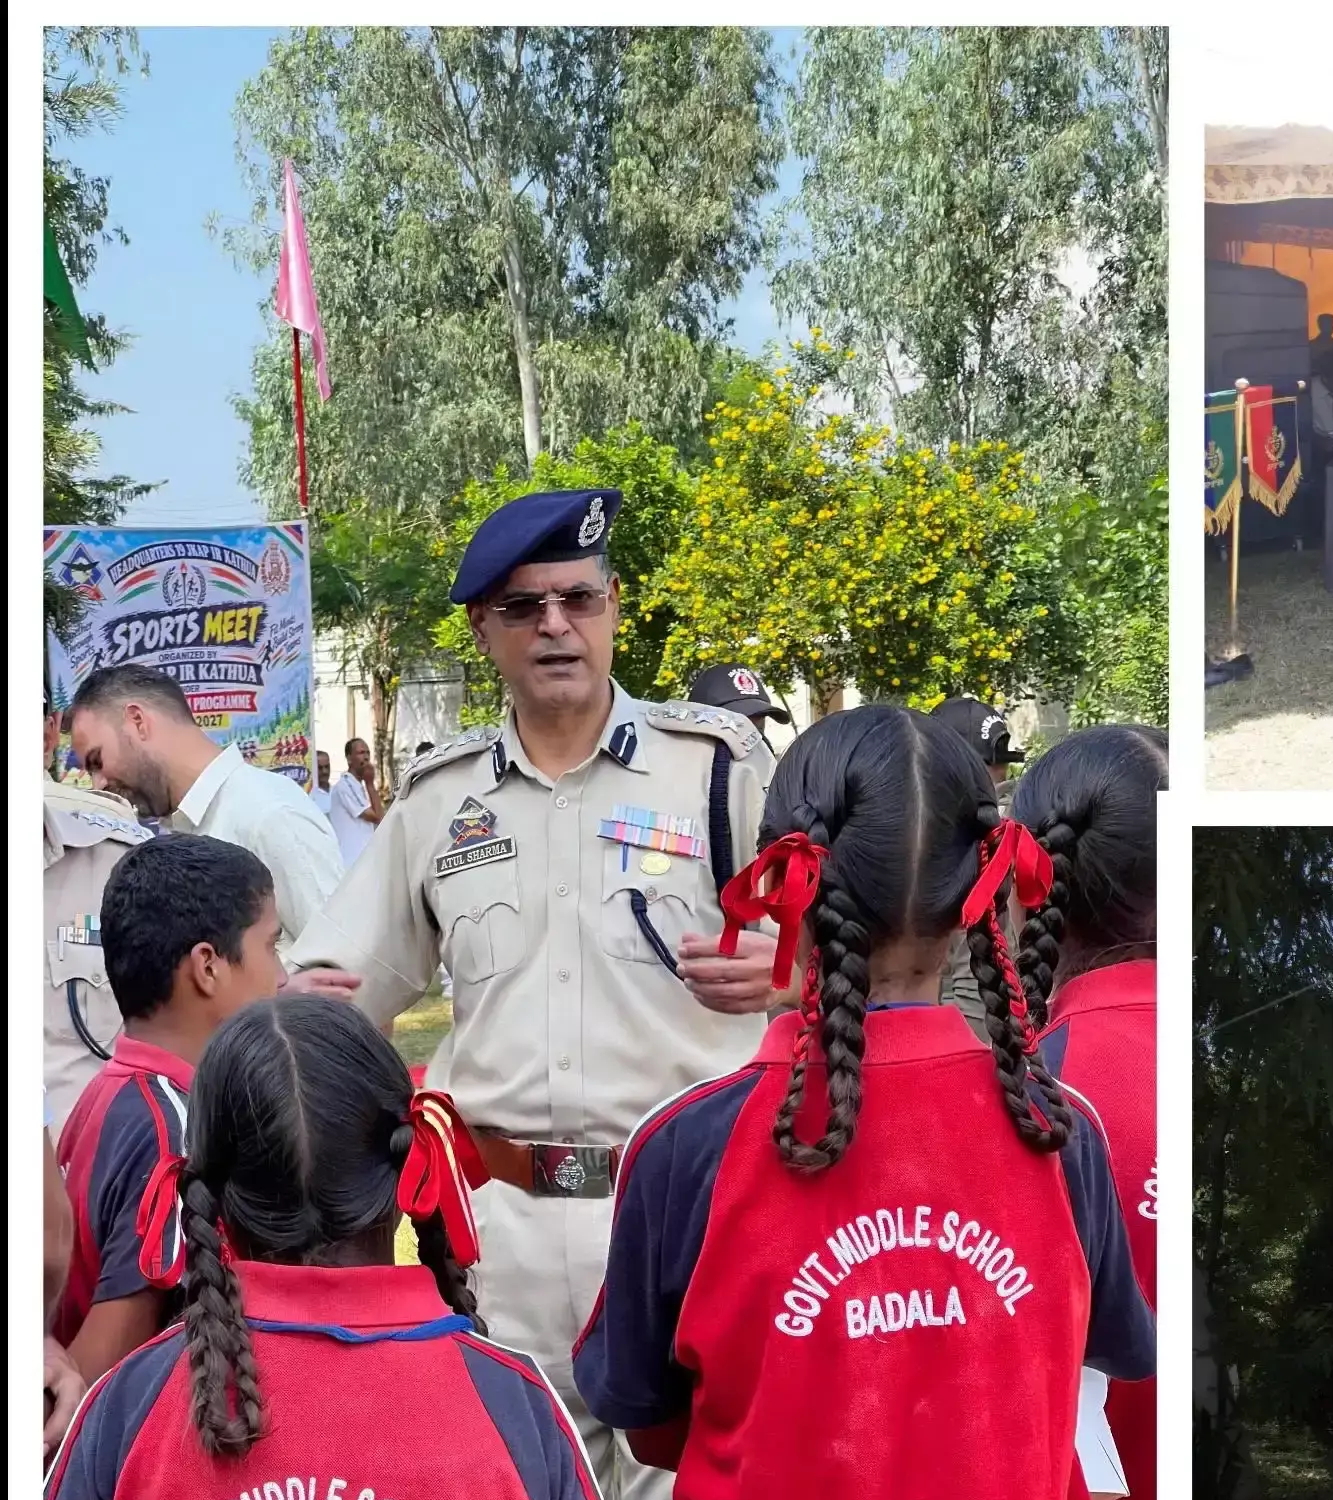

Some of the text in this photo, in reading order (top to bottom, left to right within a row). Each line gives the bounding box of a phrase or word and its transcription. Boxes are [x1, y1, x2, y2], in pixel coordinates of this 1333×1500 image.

[110, 543, 257, 581] HEADQUARTERS 19 JKAP IR KATHUA
[112, 611, 200, 661] SPORTS
[203, 605, 263, 644] MEET
[159, 650, 217, 661] ORGANIZED BY
[180, 664, 195, 681] IR
[198, 663, 257, 682] KATHUA
[194, 695, 252, 711] PROGRAMME
[196, 714, 223, 727] 2027
[441, 843, 507, 870] ATUL SHARMA
[938, 1210, 1034, 1316] SCHOOL
[845, 1285, 967, 1339] BADALA
